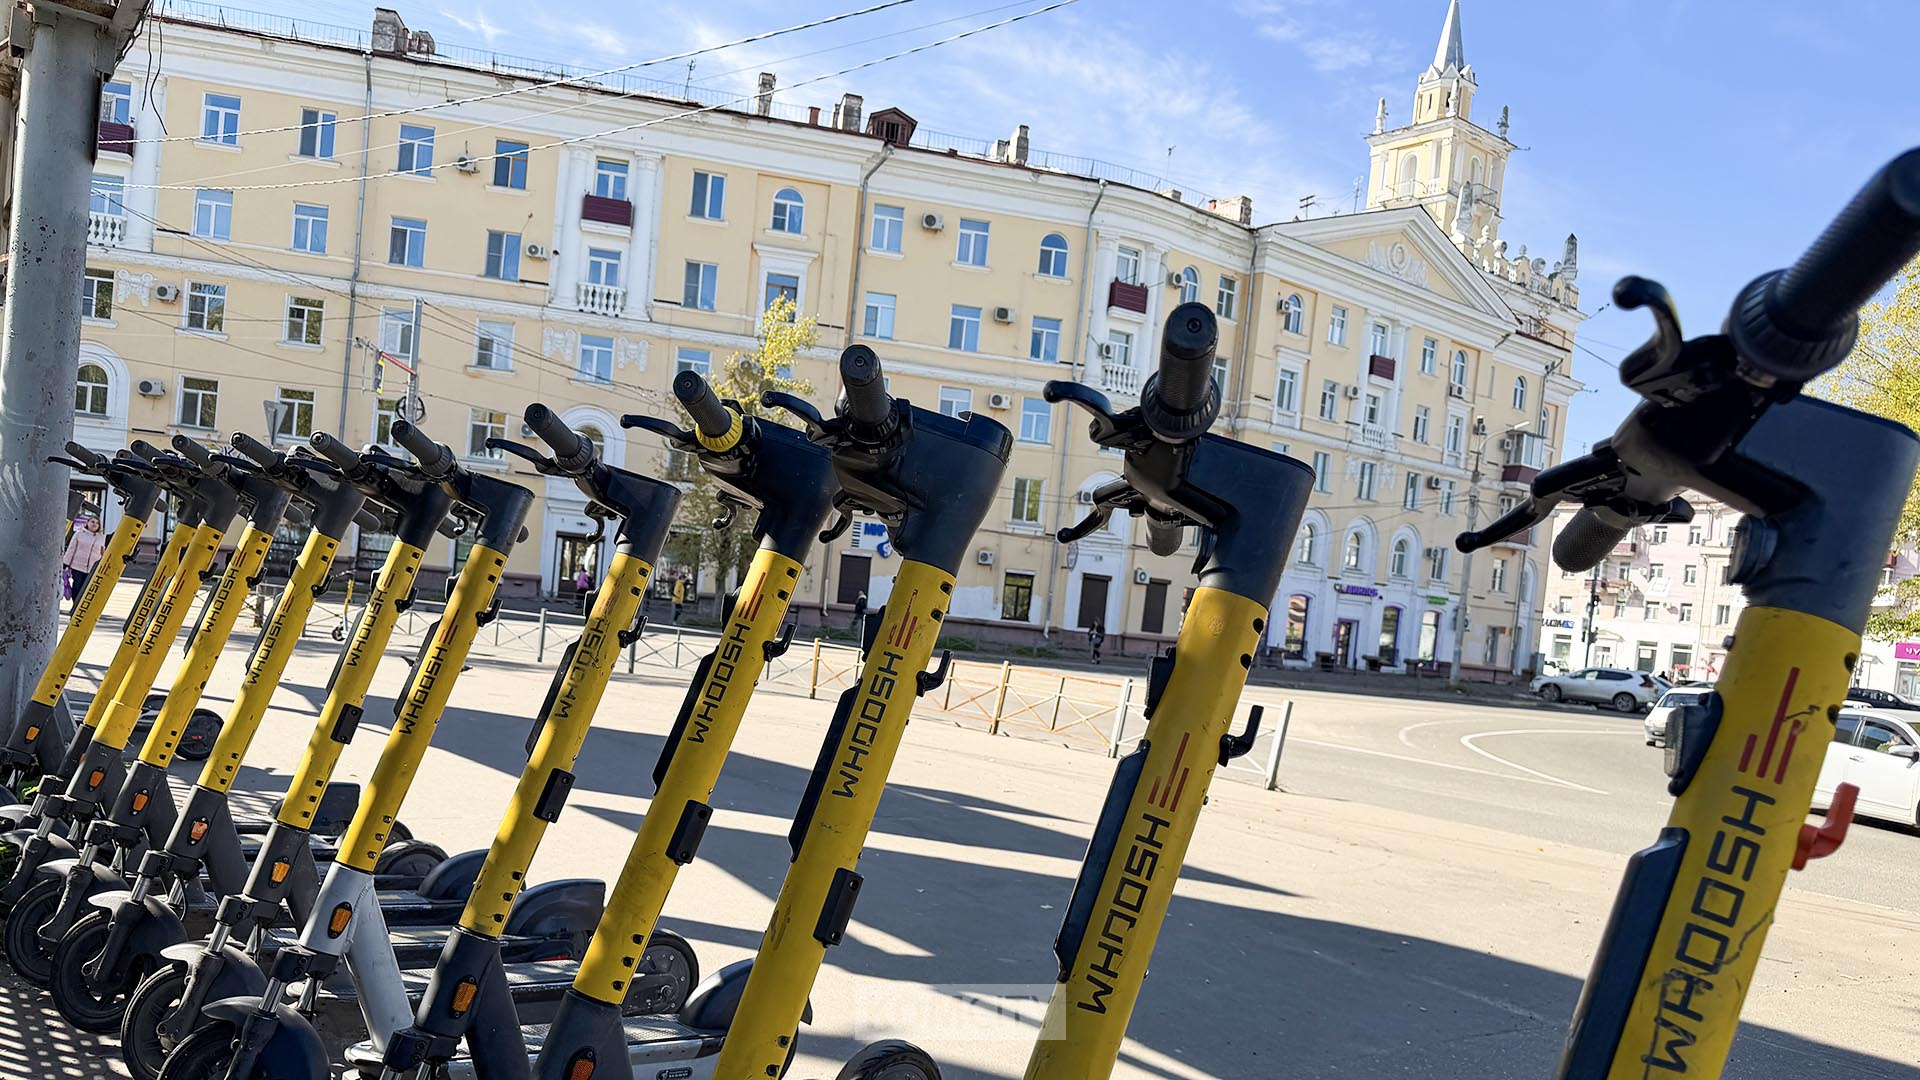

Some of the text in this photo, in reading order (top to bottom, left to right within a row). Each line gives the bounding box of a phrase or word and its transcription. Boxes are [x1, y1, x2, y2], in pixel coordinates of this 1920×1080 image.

[74, 576, 103, 627] WHOOSH
[125, 590, 158, 646] WHOOSH
[141, 595, 176, 655] WHOOSH
[202, 568, 239, 633] WHOOSH
[347, 590, 388, 667] WHOOSH
[248, 613, 287, 685] WHOOSH
[688, 622, 749, 743] WHOOSH
[400, 646, 447, 734] WHOOSH
[832, 651, 903, 799] WHOOSH
[1077, 813, 1170, 1014] WHOOSH
[1641, 785, 1776, 1073] WHOOSH
